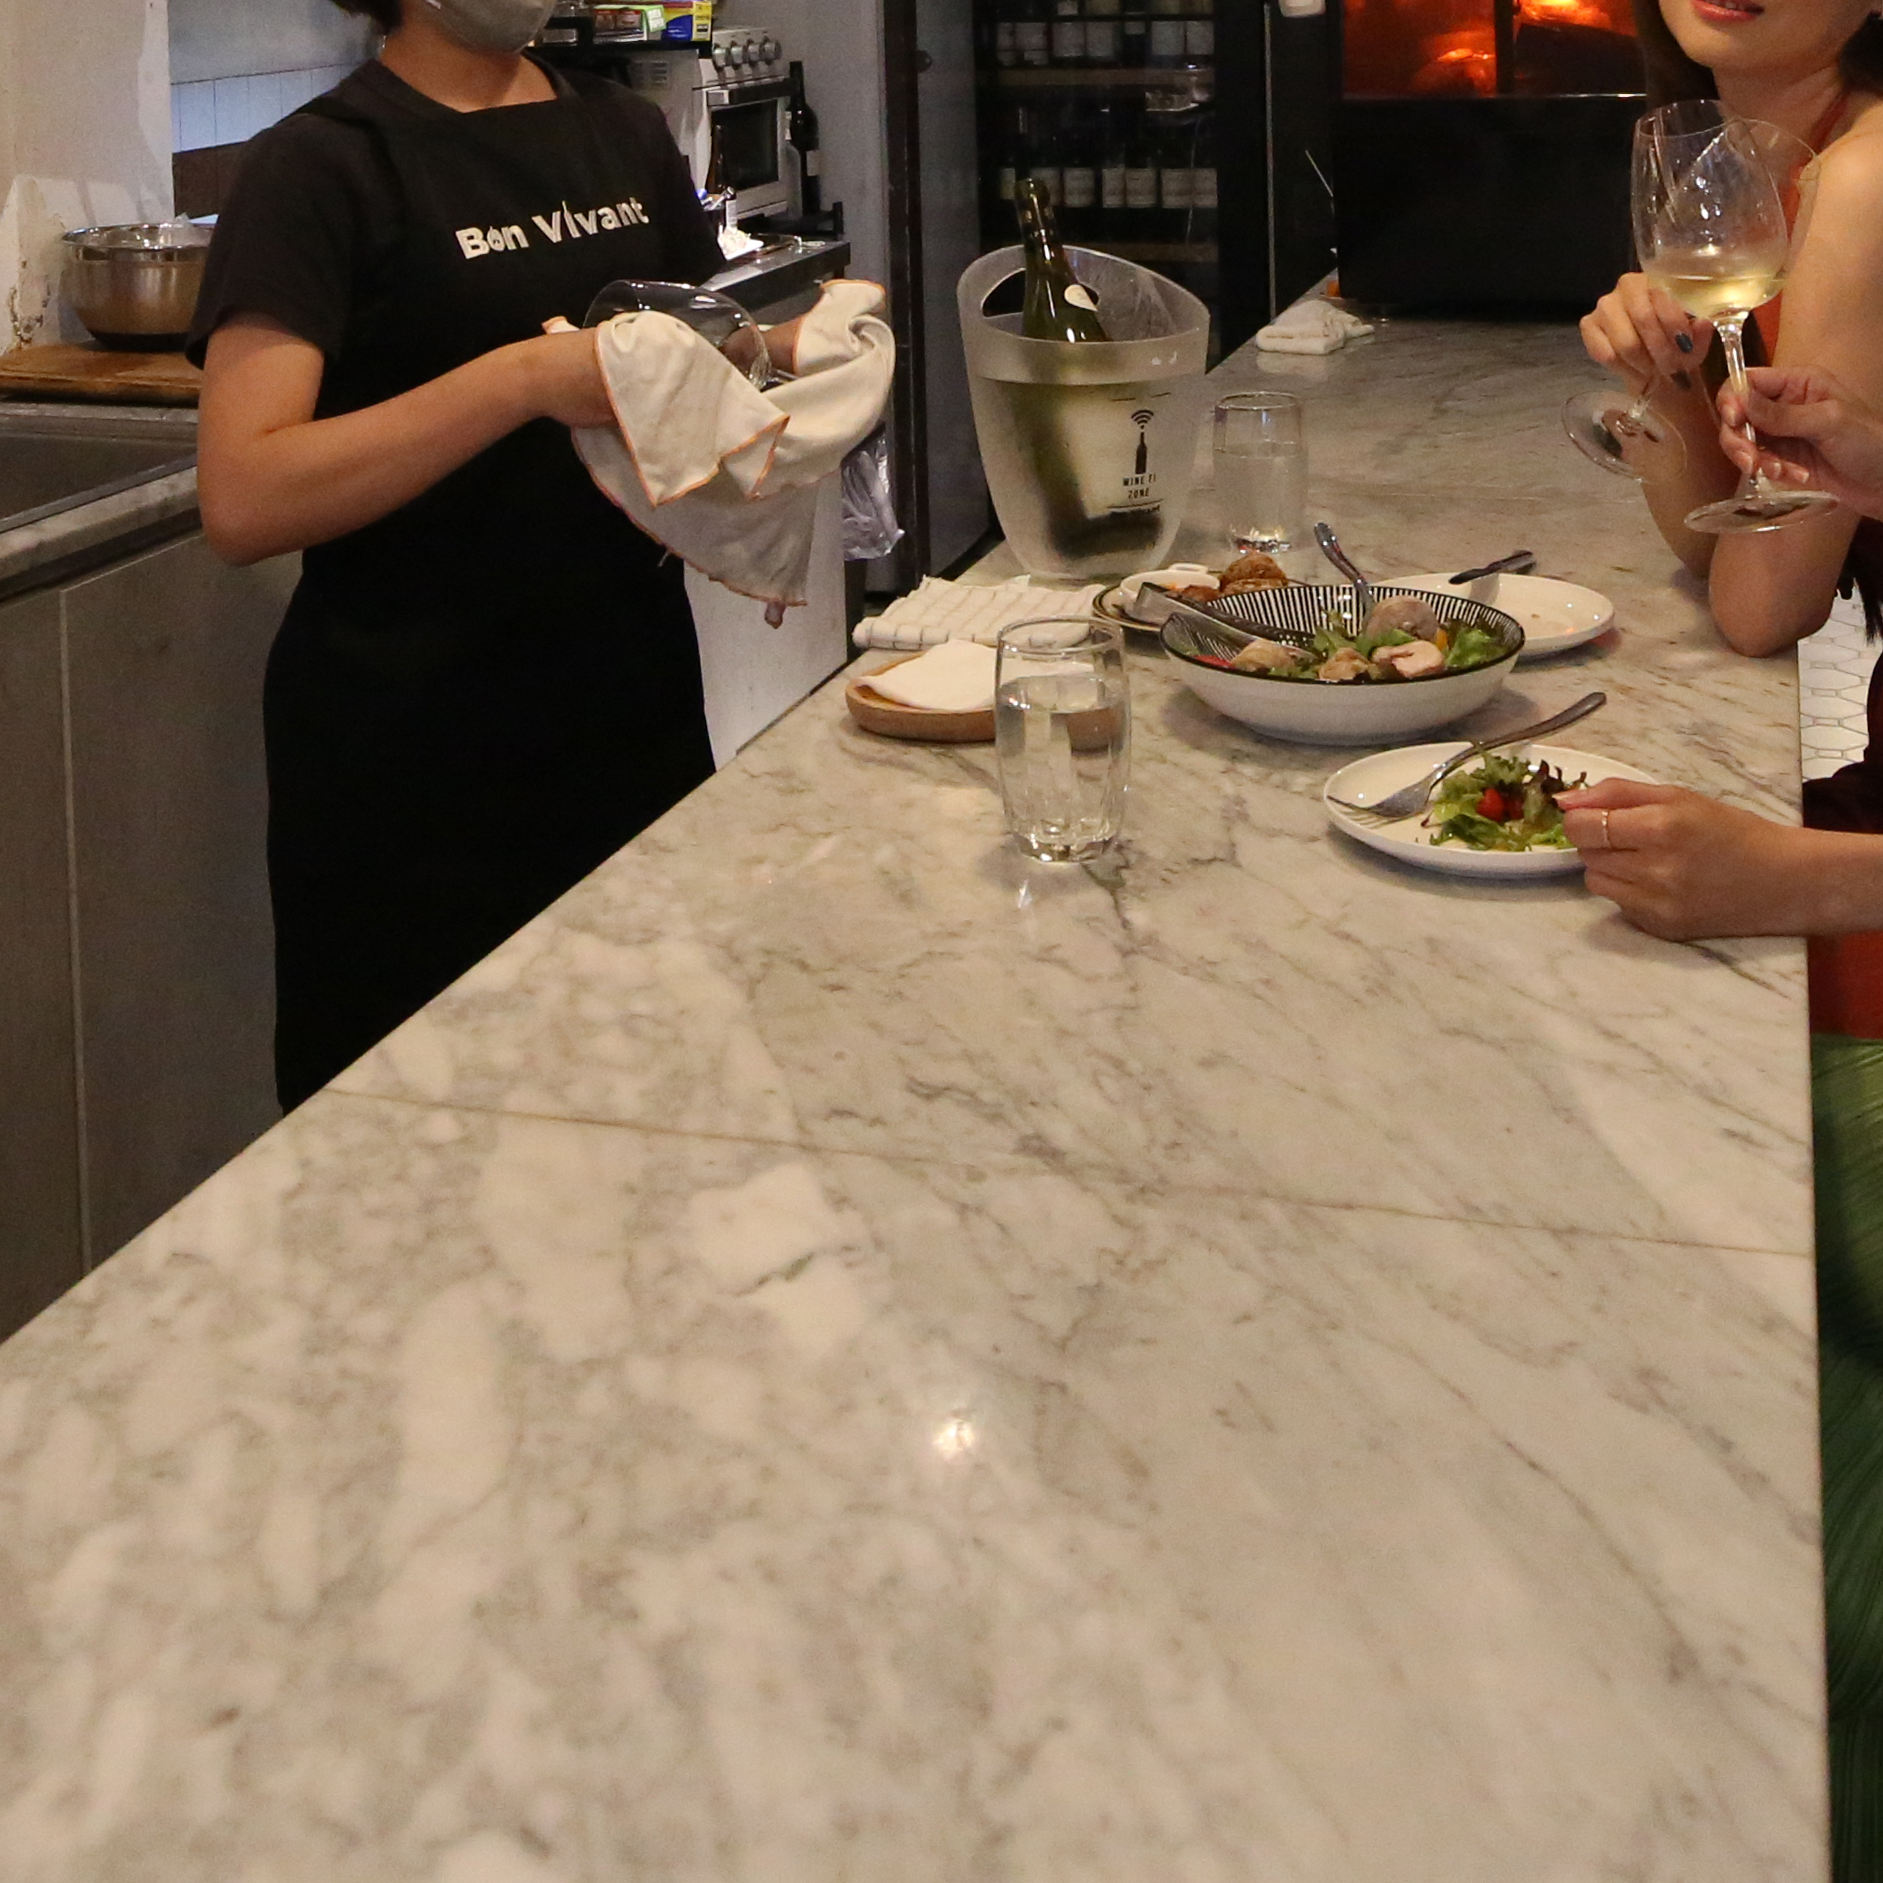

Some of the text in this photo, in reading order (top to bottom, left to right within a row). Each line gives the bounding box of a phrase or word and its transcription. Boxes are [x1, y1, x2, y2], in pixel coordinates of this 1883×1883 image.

[455, 197, 650, 260] Bon Vivant
[1127, 487, 1150, 500] ZONE
